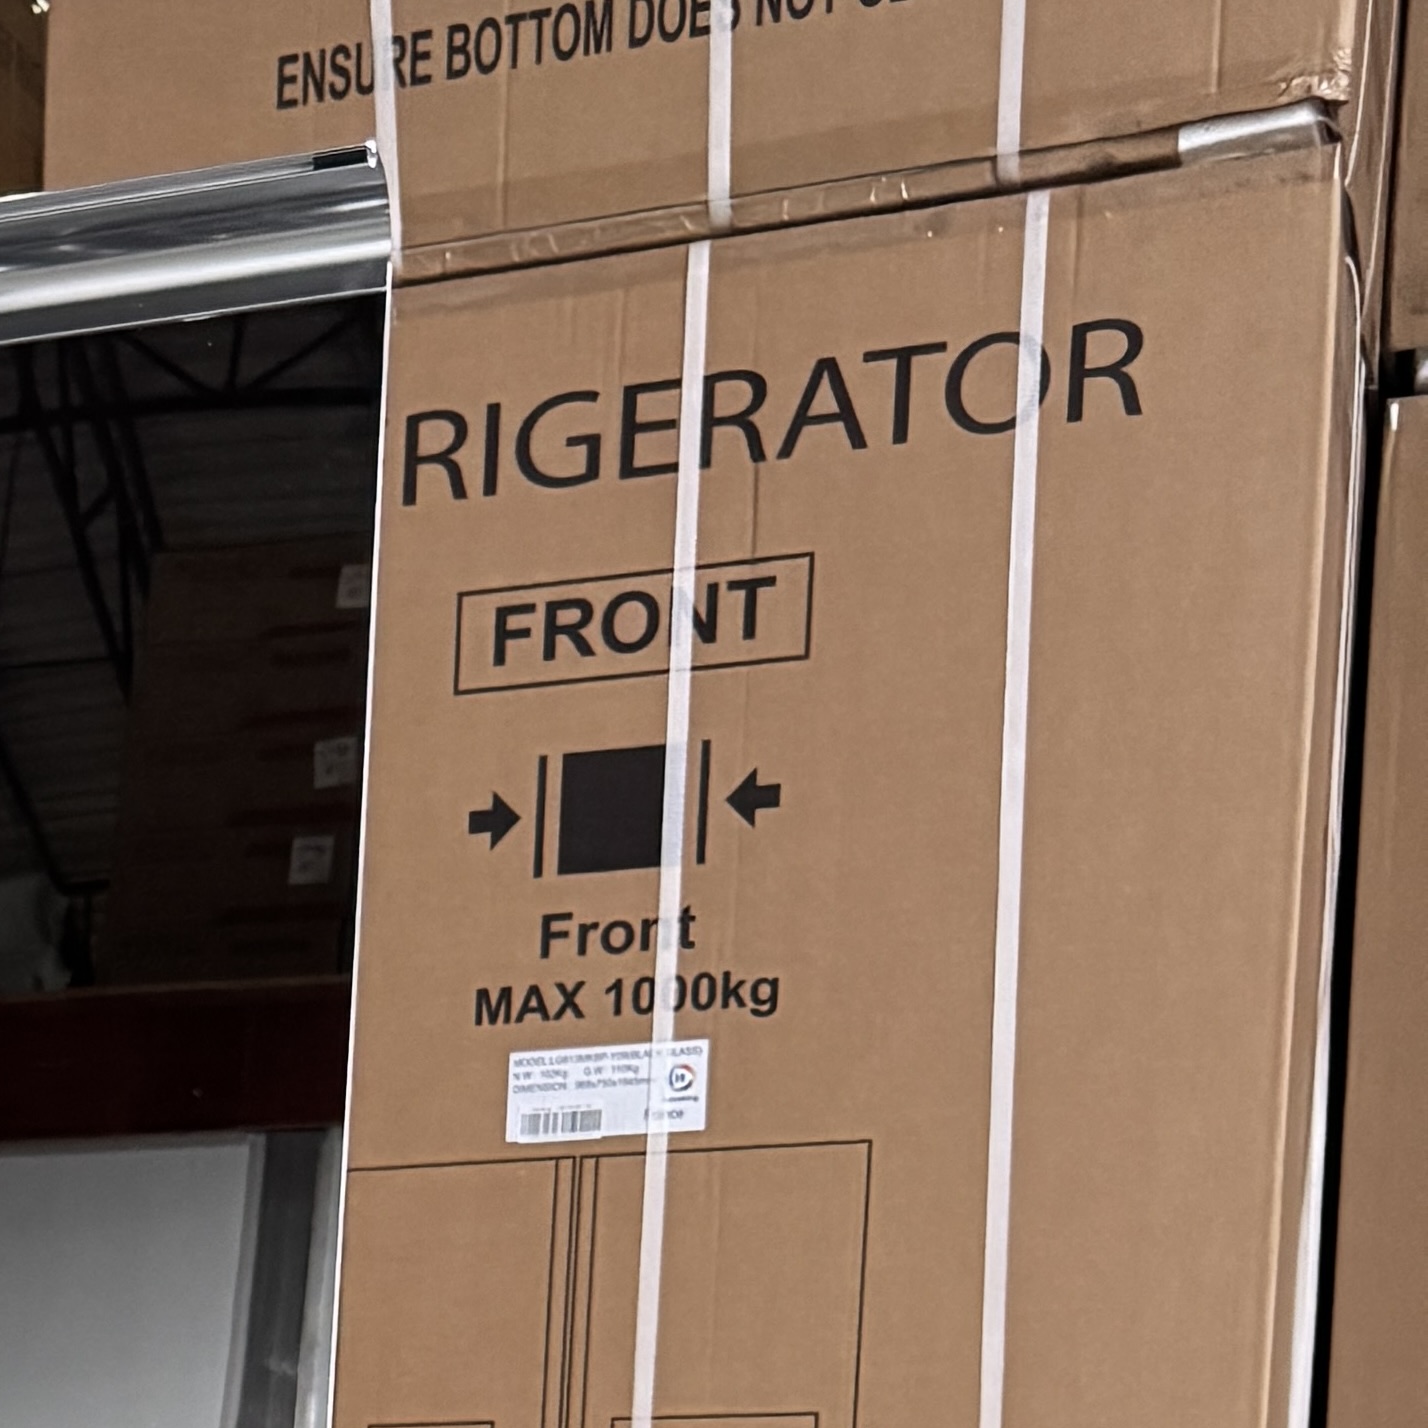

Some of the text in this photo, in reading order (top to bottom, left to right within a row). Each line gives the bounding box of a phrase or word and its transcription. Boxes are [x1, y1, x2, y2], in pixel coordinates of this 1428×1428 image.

[276, 0, 740, 110] ENSURE BOTTOM DOE
[401, 318, 1145, 507] RIGERATOR
[492, 576, 777, 668] FRONT
[540, 905, 697, 960] Front
[474, 980, 586, 1027] MAX
